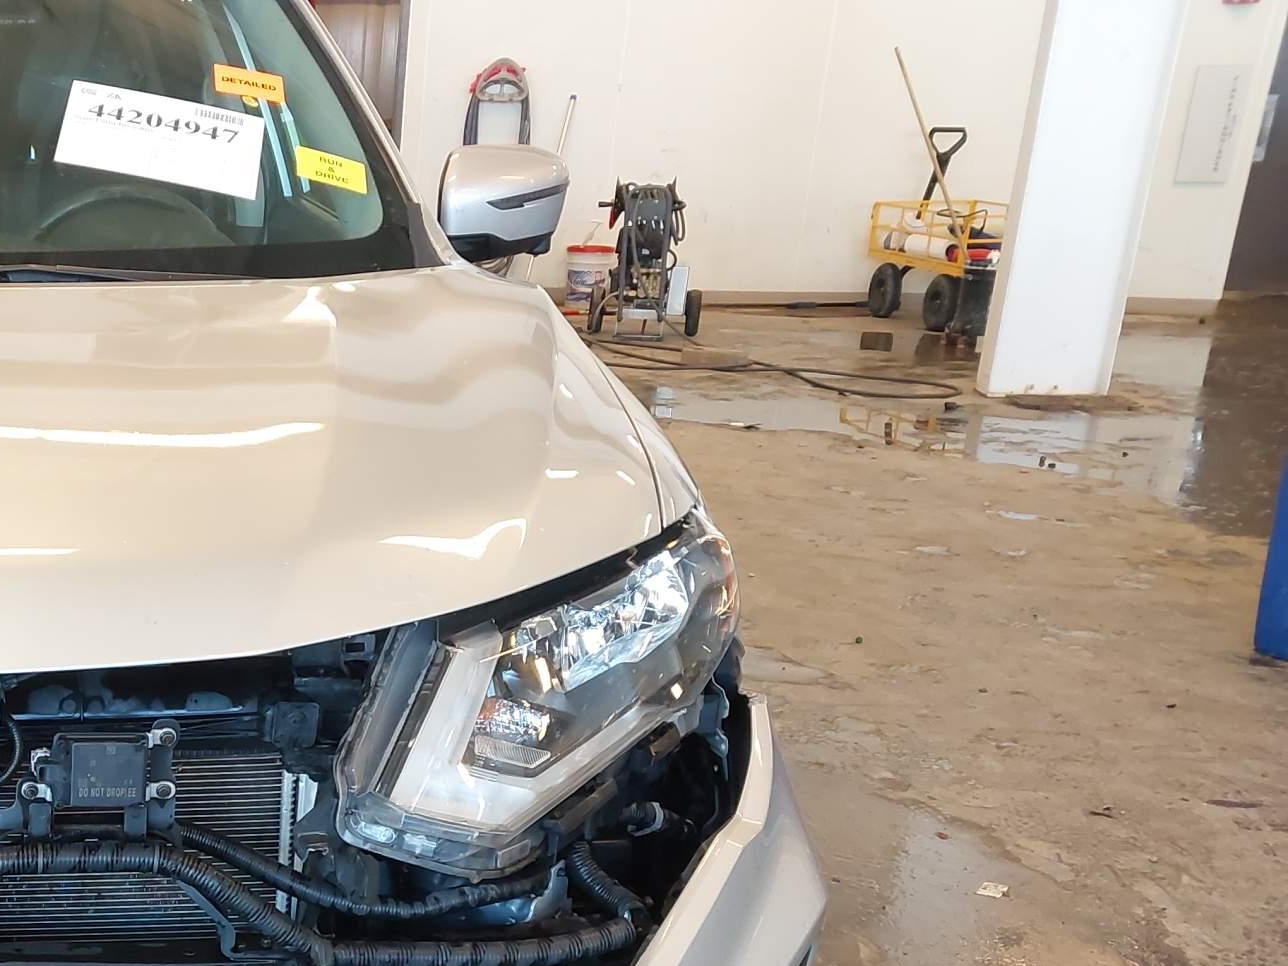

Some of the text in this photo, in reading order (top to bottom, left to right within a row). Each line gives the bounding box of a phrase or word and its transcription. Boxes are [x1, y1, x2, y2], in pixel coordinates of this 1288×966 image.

[221, 75, 276, 91] DETAILED
[87, 103, 239, 143] 44204947
[319, 156, 343, 168] RUN
[315, 170, 349, 184] DRIVE
[78, 787, 89, 798] DO
[90, 787, 104, 798] NOT
